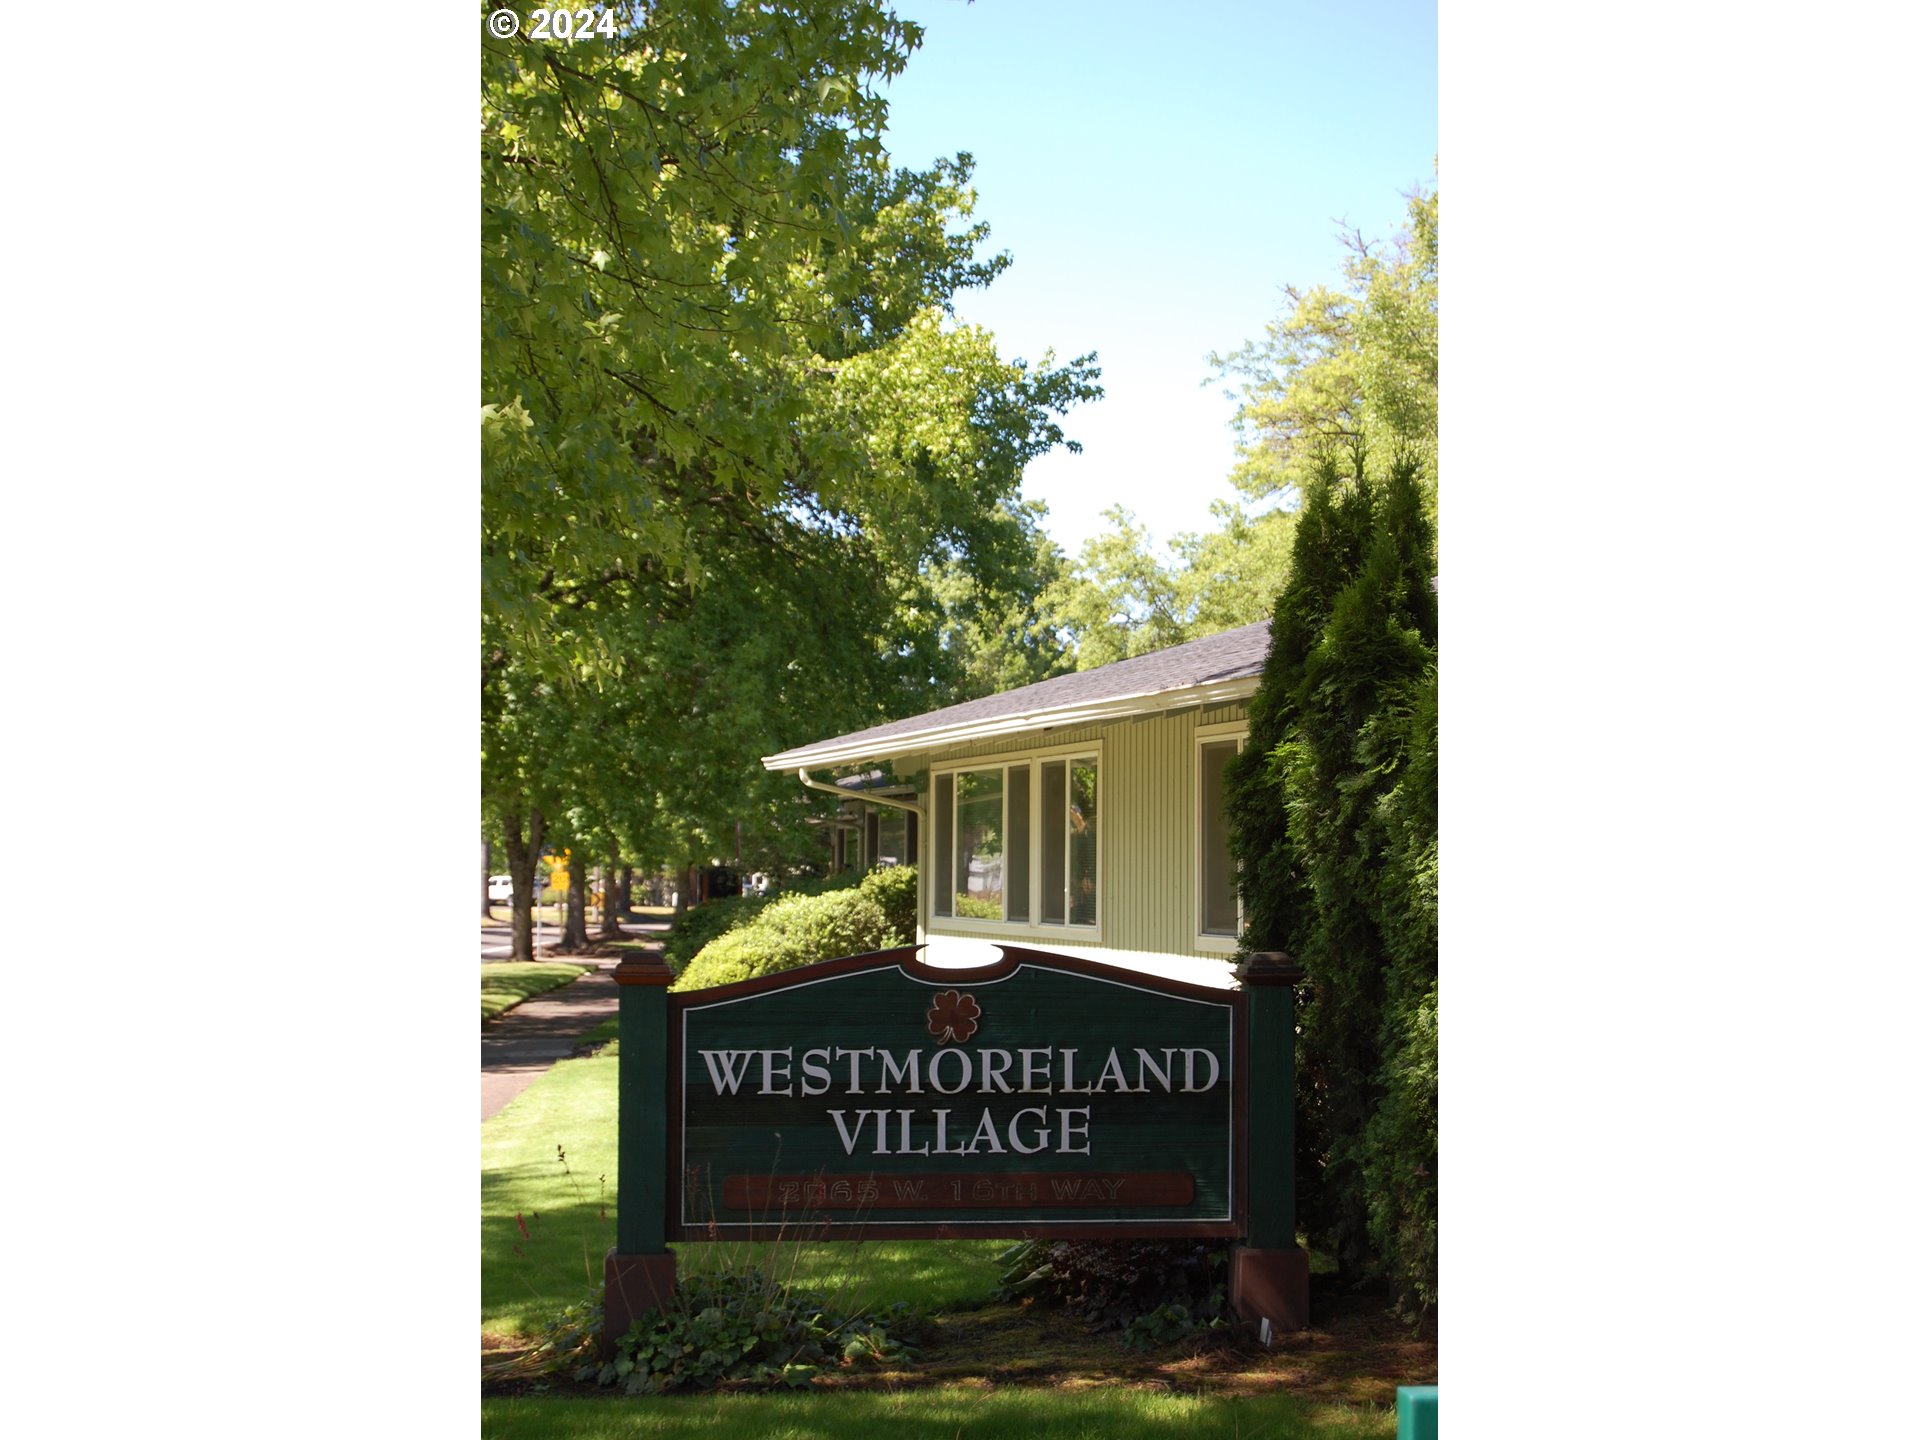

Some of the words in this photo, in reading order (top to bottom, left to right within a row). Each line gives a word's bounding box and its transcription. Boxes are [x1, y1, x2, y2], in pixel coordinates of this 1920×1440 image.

[698, 1046, 1220, 1097] WESTMORELAND
[827, 1105, 1091, 1156] VILLAGE
[893, 1180, 928, 1201] W.
[1051, 1177, 1127, 1200] WAY
